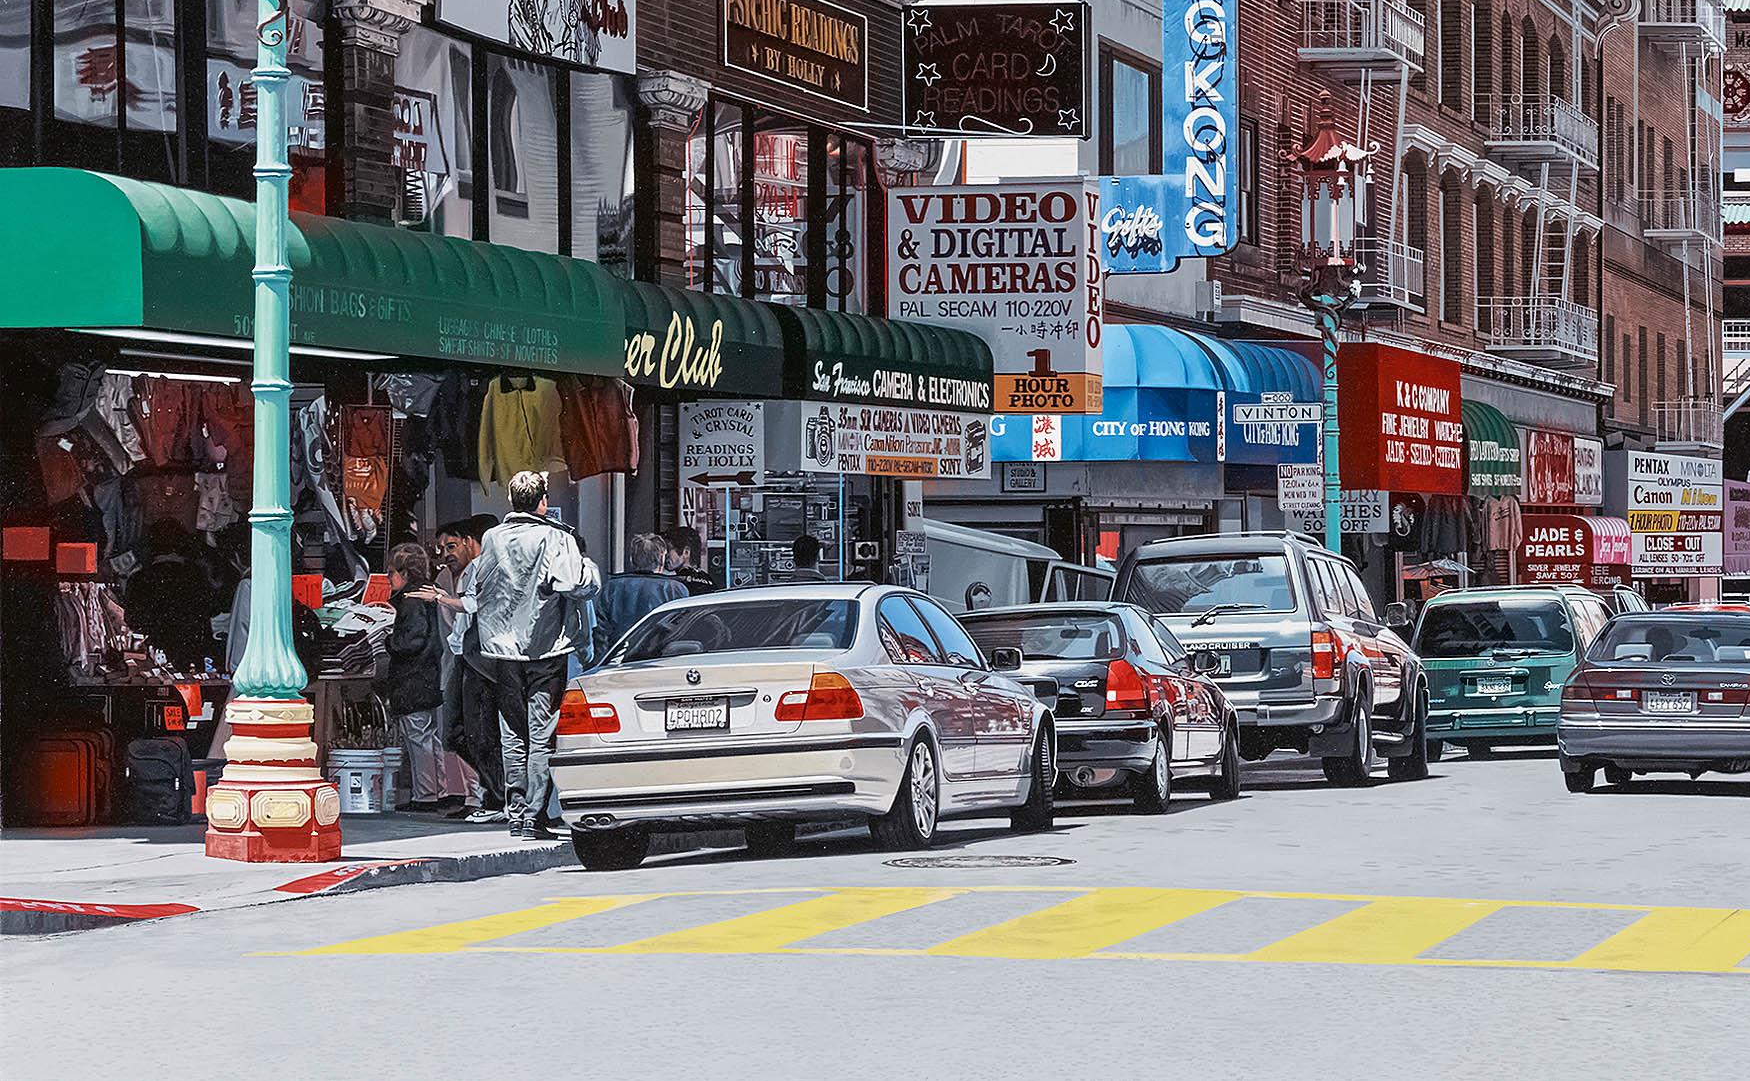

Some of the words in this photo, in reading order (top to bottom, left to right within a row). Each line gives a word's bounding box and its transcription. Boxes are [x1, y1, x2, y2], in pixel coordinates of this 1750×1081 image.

[790, 3, 860, 65] READINGS
[912, 17, 980, 56] PALM
[995, 14, 1075, 54] TAROT
[765, 47, 781, 73] BY
[786, 55, 825, 87] HOLLY
[952, 52, 1031, 82] CARD
[923, 87, 1060, 114] READINGS
[1184, 62, 1227, 247] KONG
[897, 192, 1077, 224] VIDEO
[1102, 204, 1163, 247] Gifts
[897, 228, 920, 260] &
[930, 227, 1077, 259] DIGITAL
[898, 261, 1077, 295] CAMERAS
[1085, 192, 1101, 349] VIDEO
[331, 289, 367, 318] BAGS
[900, 301, 931, 317] PAL
[938, 301, 998, 317] SECAM
[660, 310, 722, 389] Club
[1026, 348, 1057, 378] 1
[812, 360, 830, 392] San
[872, 369, 913, 401] CAMERA
[917, 378, 925, 403] &
[928, 376, 990, 409] ELECTRONICS
[1014, 378, 1071, 394] HOUR
[1009, 395, 1075, 408] PHOTO
[1396, 381, 1404, 407] K
[1405, 382, 1411, 407] &
[1418, 386, 1450, 415] COMPANY
[690, 407, 724, 425] TAROT
[727, 407, 754, 423] CARD
[873, 411, 903, 433] CAMERAS
[911, 413, 931, 434] VIDEO
[932, 415, 961, 436] CAMERAS
[1241, 407, 1312, 419] VINTON
[692, 429, 702, 440] &
[705, 419, 754, 438] CRYSTAL
[1092, 422, 1126, 437] CITY
[1130, 424, 1147, 436] OF
[1148, 422, 1185, 437] HONG
[1188, 422, 1210, 437] KONG
[1382, 413, 1398, 436] FINE
[1399, 415, 1430, 440] JEWELRY
[686, 444, 755, 455] READINGS
[864, 432, 884, 452] Canon
[884, 435, 904, 453] Nikon
[683, 456, 701, 467] BY
[708, 456, 756, 467] HOLLY
[838, 453, 860, 471] PENTAX
[939, 458, 961, 475] SONY
[1386, 440, 1406, 463] JADE
[1410, 443, 1432, 466] SEIKO
[1434, 445, 1461, 469] CITIZEN
[1280, 465, 1292, 478] NO
[1293, 467, 1320, 476] PARKING
[1634, 457, 1670, 475] PENTAX
[1680, 460, 1718, 478] MINOLTA
[1010, 478, 1036, 488] GALLERY
[1657, 477, 1692, 487] OLYMPUS
[1284, 491, 1295, 499] MON
[1296, 491, 1307, 499] WED
[1634, 485, 1673, 504] Canon
[1681, 488, 1717, 506] Nikon
[907, 501, 921, 518] SONY
[1340, 520, 1370, 531] OFF
[1636, 514, 1653, 531] HOUR
[1652, 514, 1674, 531] PHOTO
[1529, 528, 1569, 542] JADE
[1574, 528, 1584, 542] &
[1646, 536, 1675, 551] CLOSE
[1684, 538, 1701, 551] OUT
[1525, 544, 1585, 557] PEARLS
[1639, 553, 1650, 562] ALL
[1650, 553, 1668, 562] LENSES
[1696, 554, 1705, 562] OFF
[1527, 564, 1549, 572] SILVER
[1552, 564, 1581, 572] JEWELRY
[1655, 566, 1665, 574] ON
[1665, 566, 1674, 574] ALL
[1208, 642, 1251, 650] CRUISER
